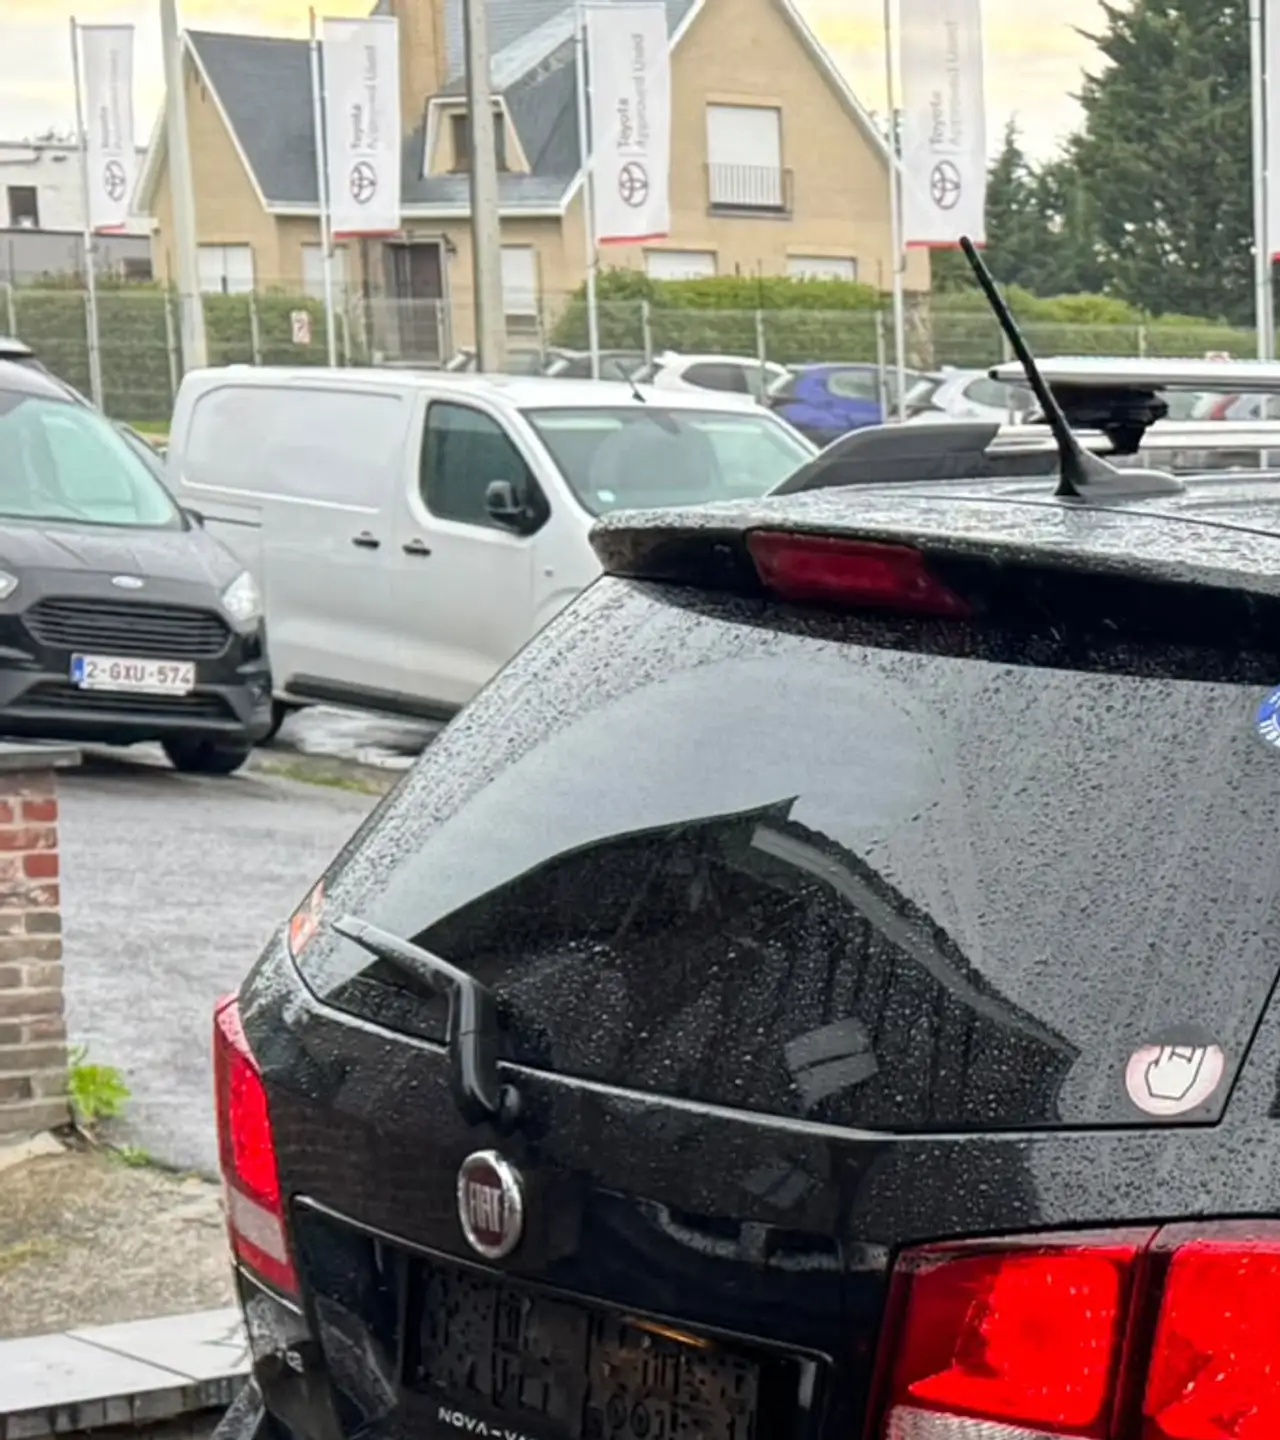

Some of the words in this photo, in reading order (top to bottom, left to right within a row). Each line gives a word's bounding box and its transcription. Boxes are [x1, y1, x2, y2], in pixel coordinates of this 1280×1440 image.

[616, 97, 633, 149] Toyota
[929, 90, 946, 145] Toyota
[86, 661, 192, 685] 2-GXU-574
[468, 1180, 502, 1233] FIAT
